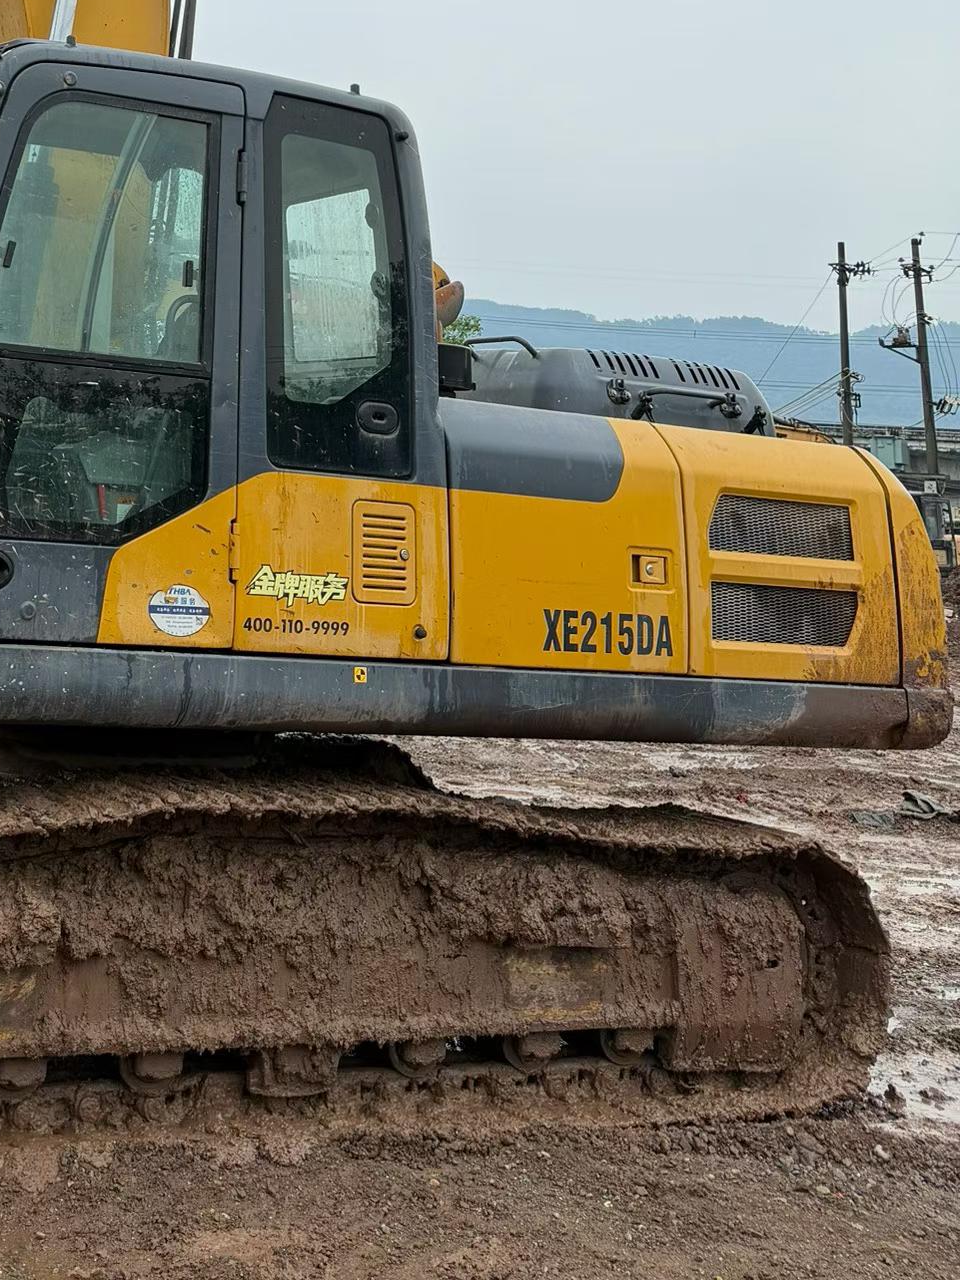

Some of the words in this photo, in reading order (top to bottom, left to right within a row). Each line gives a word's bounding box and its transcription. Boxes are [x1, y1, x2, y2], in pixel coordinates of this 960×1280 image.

[245, 564, 349, 608] 金牌服务
[243, 617, 349, 636] 400-110-9999
[543, 609, 673, 657] XE215DA
